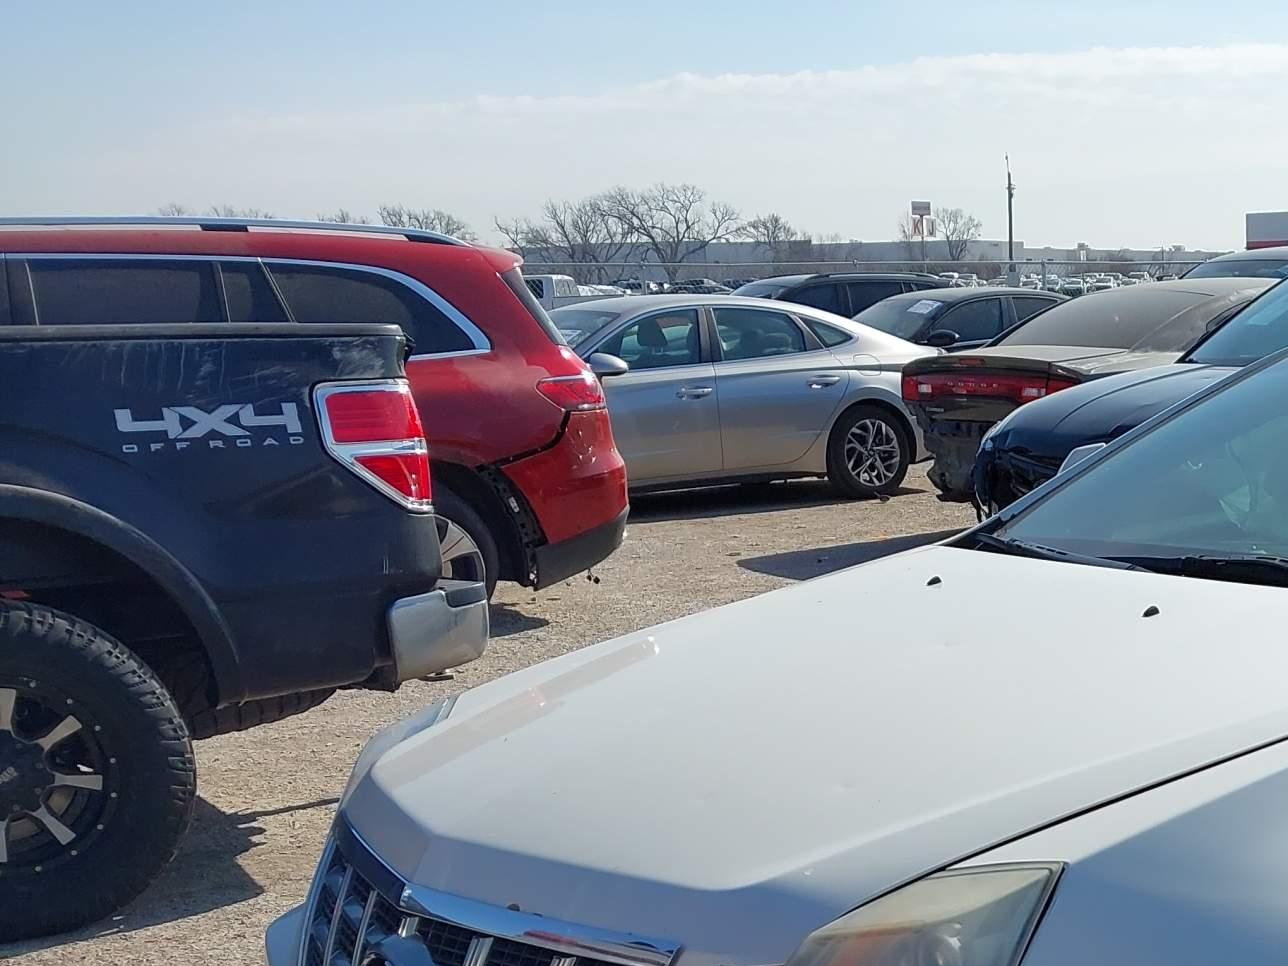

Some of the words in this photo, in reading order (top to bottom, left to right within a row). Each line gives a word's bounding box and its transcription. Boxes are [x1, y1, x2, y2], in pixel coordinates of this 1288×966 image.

[113, 402, 303, 440] 4X4
[122, 441, 191, 453] OFF
[209, 436, 305, 449] ROAD
